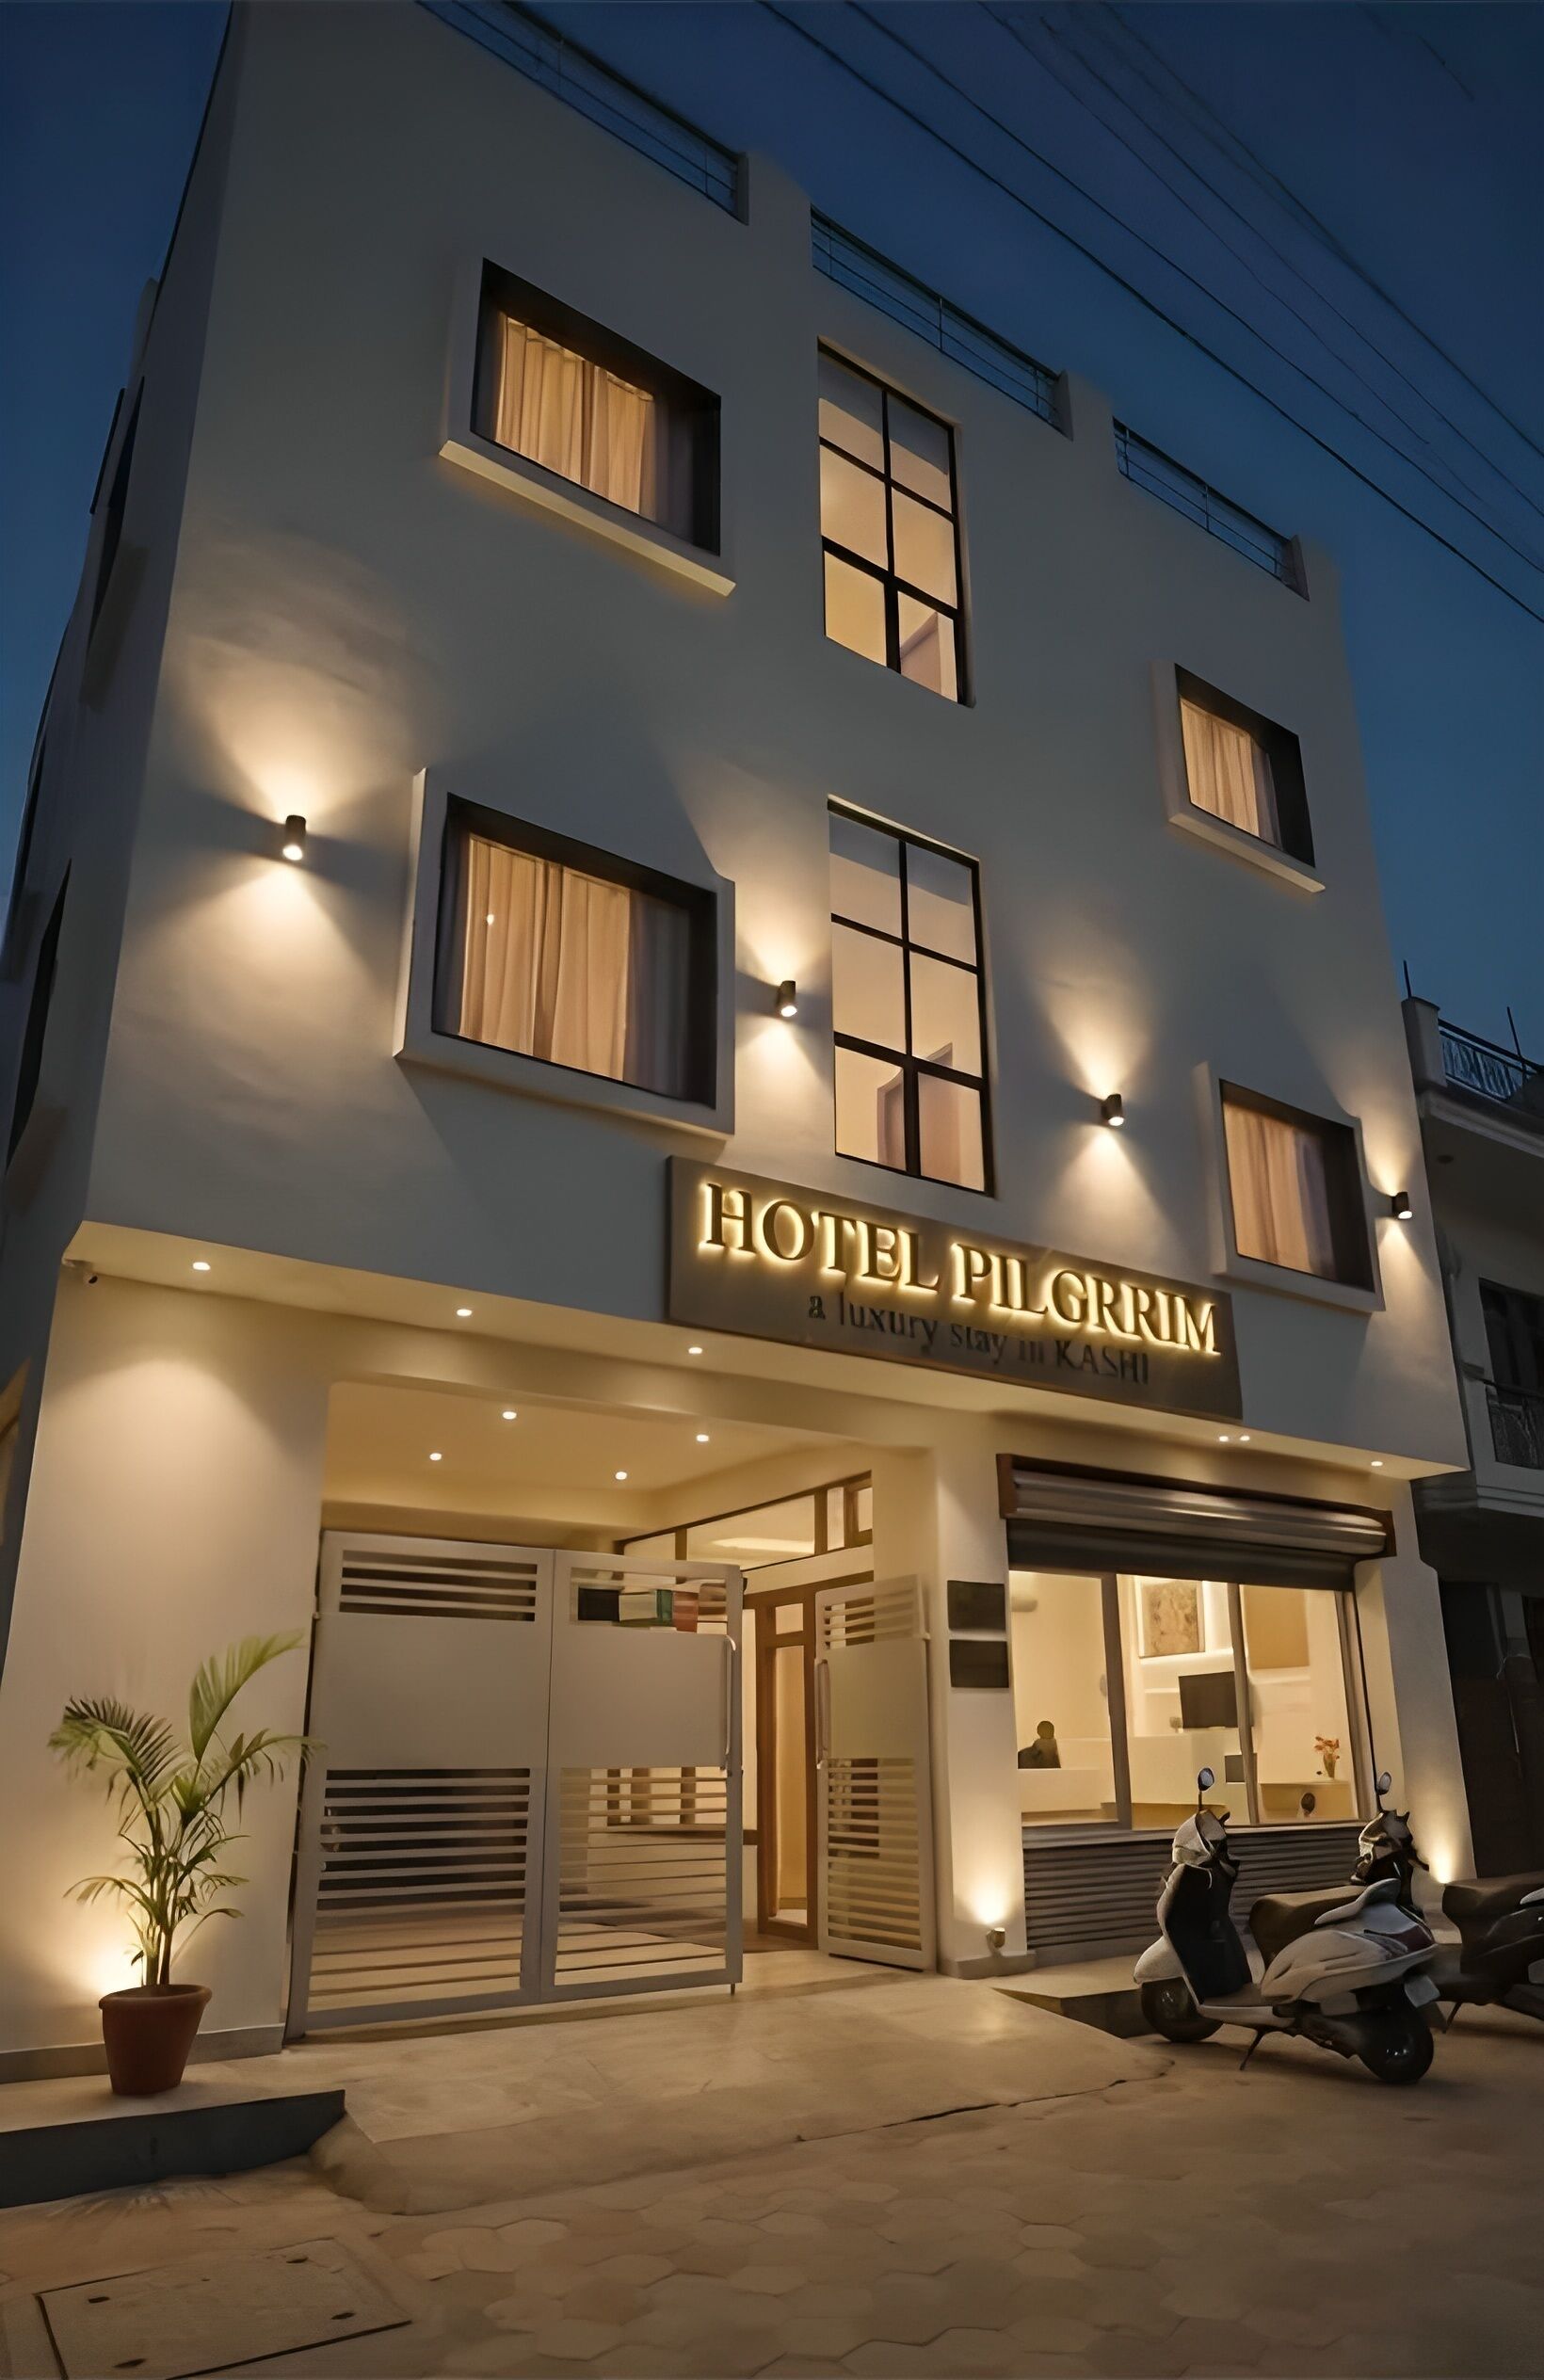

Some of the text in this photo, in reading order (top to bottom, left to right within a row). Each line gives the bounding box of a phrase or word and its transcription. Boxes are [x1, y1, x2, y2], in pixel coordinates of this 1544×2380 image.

[701, 1182, 1221, 1356] HOTEL PILGRRIM
[808, 1291, 1150, 1385] a luxury stay in KASHI
